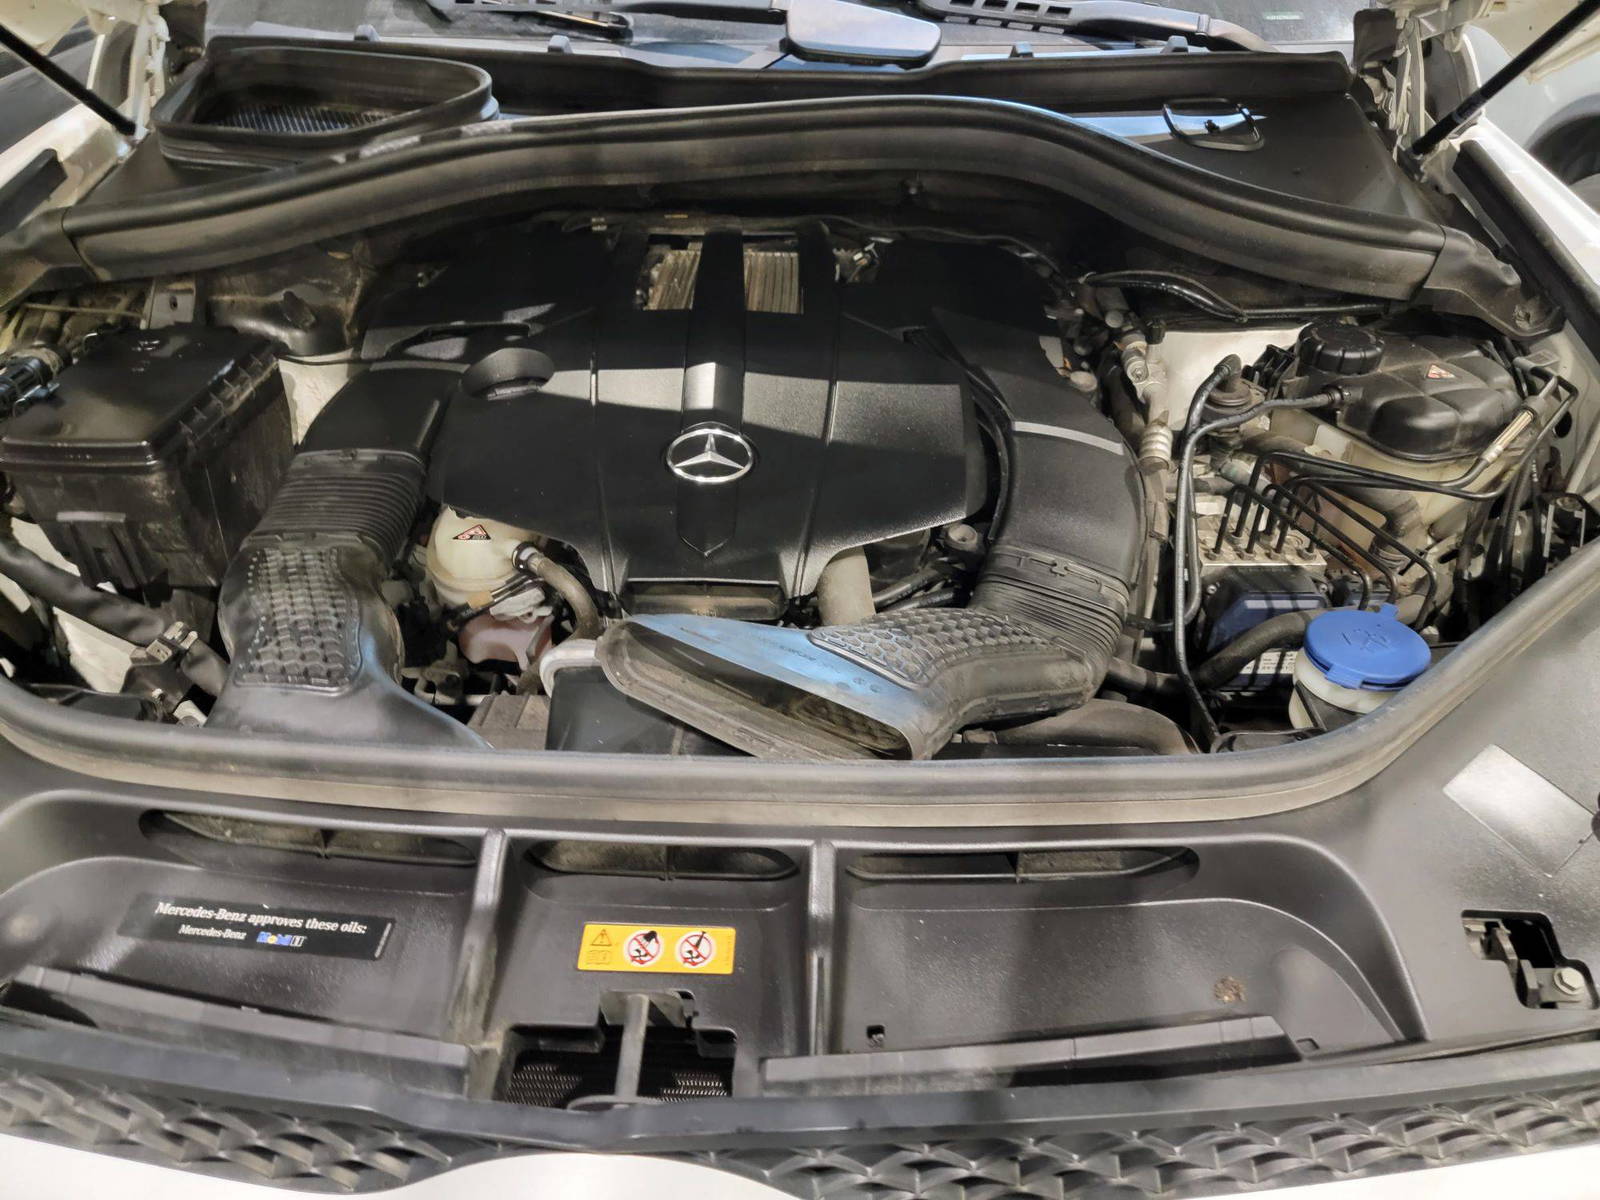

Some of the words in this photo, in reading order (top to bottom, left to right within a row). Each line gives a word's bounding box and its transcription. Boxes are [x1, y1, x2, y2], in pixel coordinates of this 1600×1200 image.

[155, 902, 247, 923] Mercedes-Benz
[248, 913, 303, 928] approves
[305, 919, 339, 932] these
[340, 923, 367, 934] oils:
[178, 924, 246, 940] Mercedes-Benz
